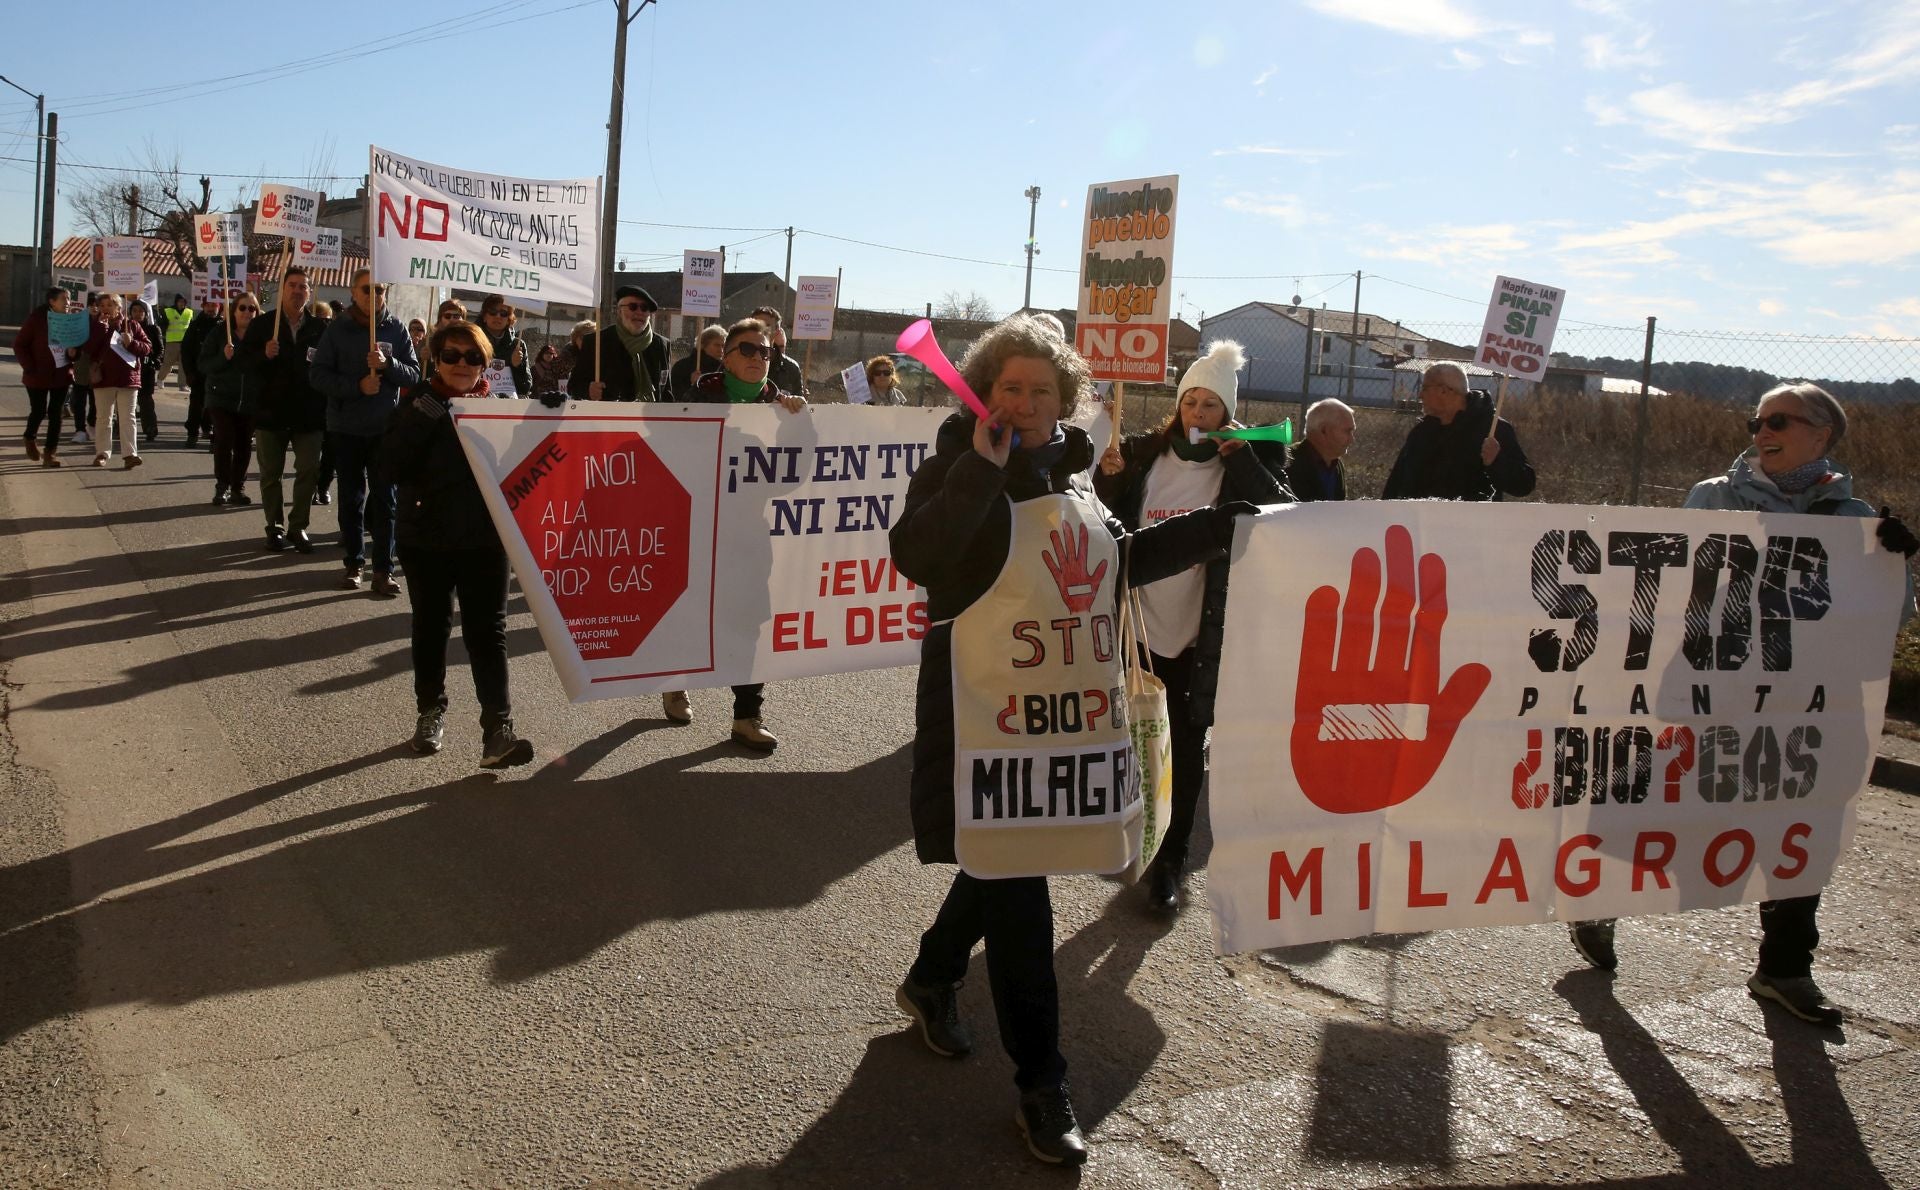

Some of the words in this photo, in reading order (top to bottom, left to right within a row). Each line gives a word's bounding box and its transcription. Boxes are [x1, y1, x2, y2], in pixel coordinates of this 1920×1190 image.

[395, 160, 414, 181] EN
[417, 166, 437, 188] TU
[439, 172, 485, 199] PUEBLO
[512, 183, 530, 202] EN
[536, 184, 555, 203] EL
[283, 194, 315, 212] STOP
[1090, 182, 1174, 219] Nuestro
[216, 221, 239, 232] STOP
[378, 192, 450, 242] NO
[461, 204, 579, 247] MACROPLANTAS
[1088, 209, 1170, 249] pueblo
[316, 233, 339, 246] STOP
[490, 245, 511, 259] DE
[409, 254, 541, 292] MUÑOVEROS
[690, 256, 715, 268] STOP
[1084, 250, 1166, 288] Nuestro
[210, 280, 244, 288] PLNTA
[685, 289, 698, 298] NO
[801, 284, 815, 292] NO
[1501, 280, 1534, 295] Mapfre
[1540, 288, 1558, 302] IAM
[798, 313, 810, 321] NO
[1089, 281, 1158, 323] hogar
[1498, 292, 1553, 317] PINAR
[1082, 327, 1159, 359] NO
[1485, 332, 1544, 357] PLANTA
[1112, 358, 1121, 372] de
[1481, 346, 1540, 373] NO
[486, 372, 501, 381] NO
[508, 442, 568, 512] UMATE
[583, 450, 637, 490] ¡NO!
[727, 446, 803, 494] ¡NI
[812, 444, 870, 483] EN
[877, 443, 928, 479] TU
[540, 500, 556, 525] A
[563, 500, 588, 524] LA
[769, 498, 825, 536] NI
[834, 494, 894, 533] EN
[1147, 509, 1193, 519] MILA
[544, 528, 631, 561] PLANTA
[639, 527, 666, 556] DE
[608, 564, 653, 593] GAS
[818, 557, 916, 598] ¡EVI
[1527, 527, 1833, 673] STOP
[565, 617, 597, 627] EMAYOR
[598, 616, 610, 624] DE
[611, 614, 641, 623] PILILLA
[571, 628, 619, 640] ATAFORMA
[772, 610, 828, 653] EL
[845, 601, 933, 646] DES
[578, 641, 611, 652] ECINAL
[1011, 613, 1119, 669] STO
[996, 686, 1127, 736] ¿BIO?G
[1517, 684, 1827, 718] PLANTA
[1510, 724, 1823, 810] ¿BIO?GAS
[1266, 821, 1813, 922] MILAGROS
